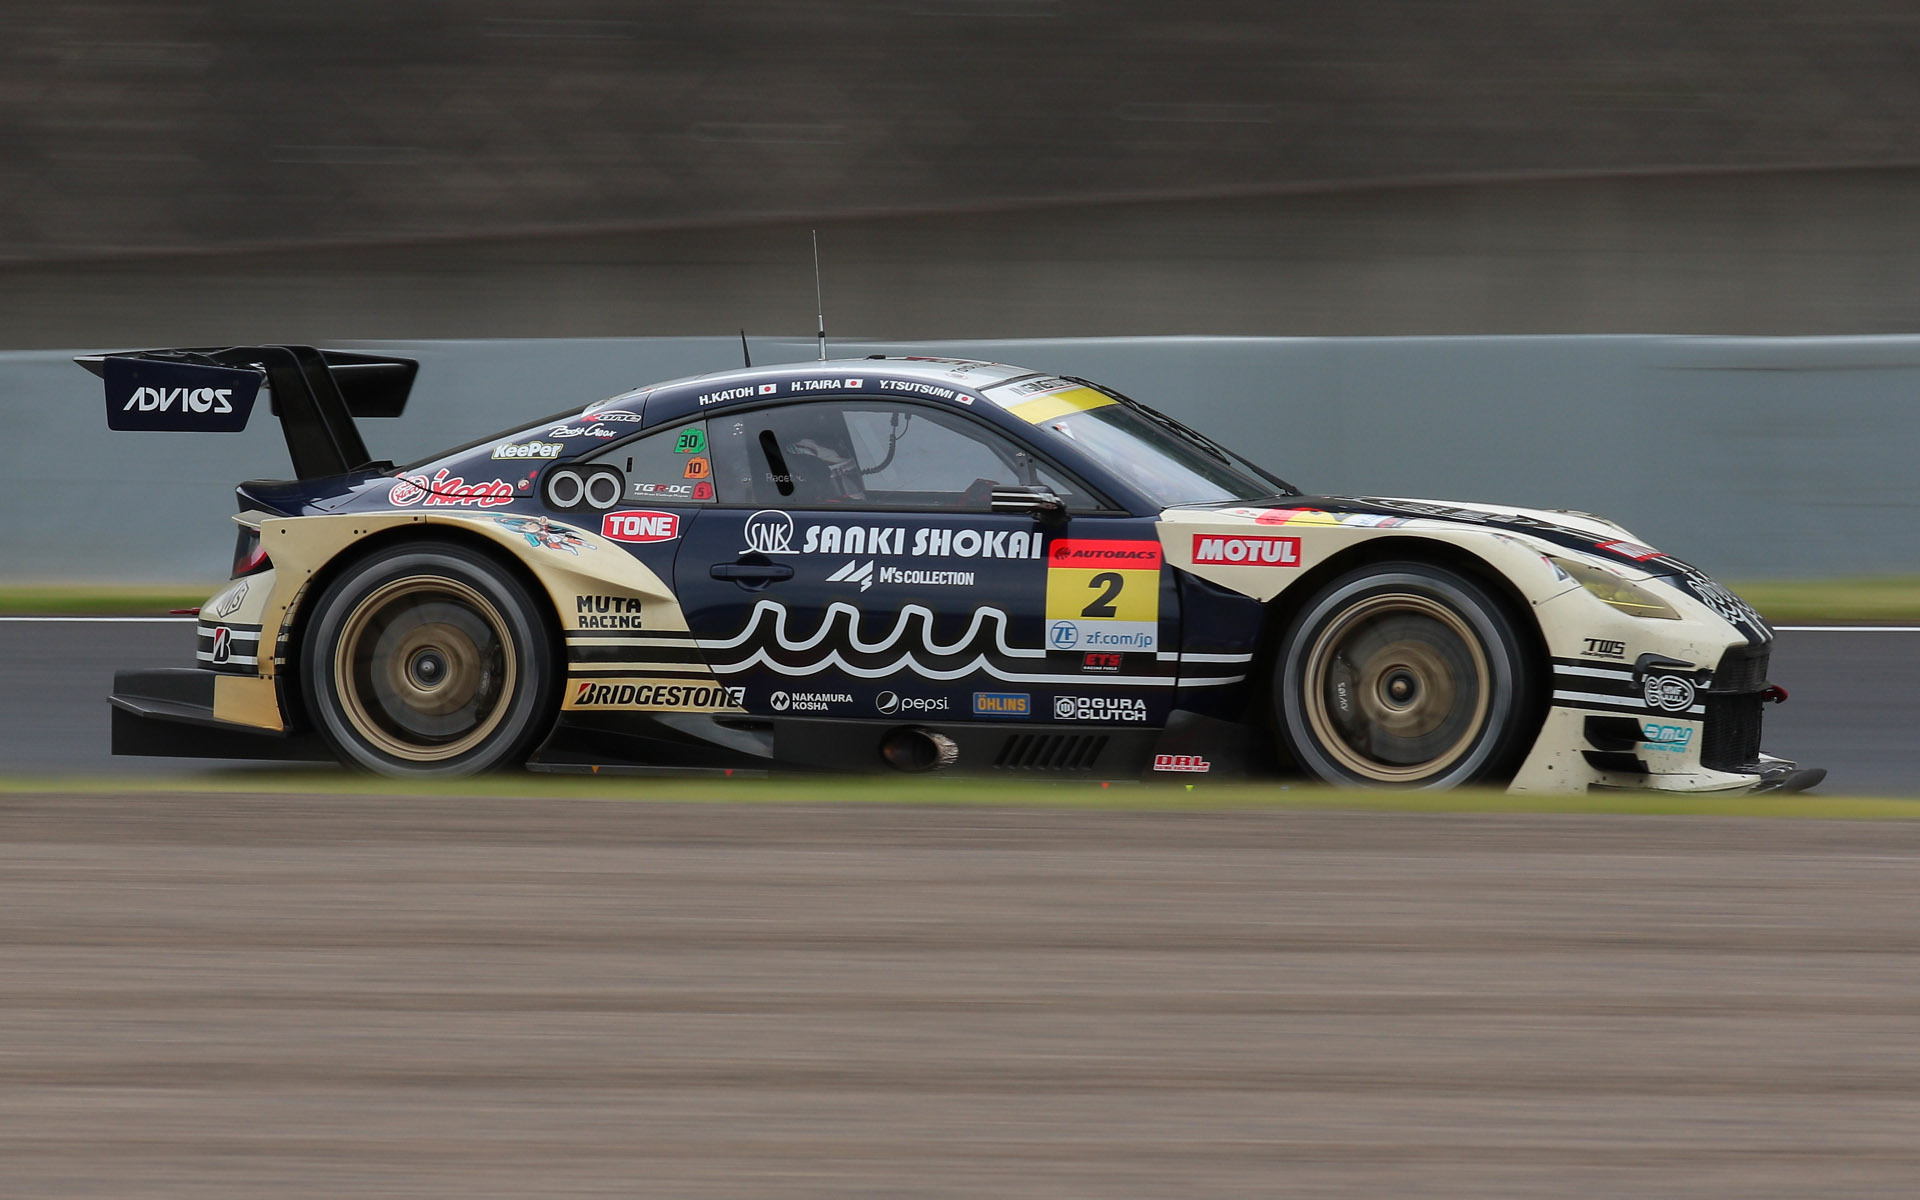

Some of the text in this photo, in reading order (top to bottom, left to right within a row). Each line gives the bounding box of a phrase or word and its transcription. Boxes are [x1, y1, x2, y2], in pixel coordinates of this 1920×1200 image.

[791, 379, 841, 392] H.TAIRA
[879, 380, 955, 399] Y.TSUTSUMI
[699, 386, 754, 406] H.KATOH
[679, 434, 698, 448] 30
[494, 442, 562, 459] KeePer
[688, 462, 702, 474] 10
[634, 483, 692, 494] TGR-DC
[609, 516, 673, 537] TONE
[803, 525, 1043, 559] SANKI SHOKAI
[1072, 550, 1156, 560] AUTOBACS
[1196, 538, 1297, 563] MOTUL
[1080, 572, 1124, 618] 2
[576, 595, 642, 613] MUTA
[578, 615, 642, 628] RACING
[1053, 624, 1153, 648] ZF zf.com/jp
[1584, 637, 1626, 655] TWS
[1085, 653, 1121, 667] ETS
[574, 683, 746, 708] BRIDGESTONE
[792, 692, 853, 702] NAKAMURA
[978, 693, 1026, 711] ÖHLINS
[1077, 697, 1147, 709] OGURA
[792, 701, 828, 711] KOSHA
[901, 696, 949, 712] pepsi
[1077, 709, 1147, 721] CLUTCH
